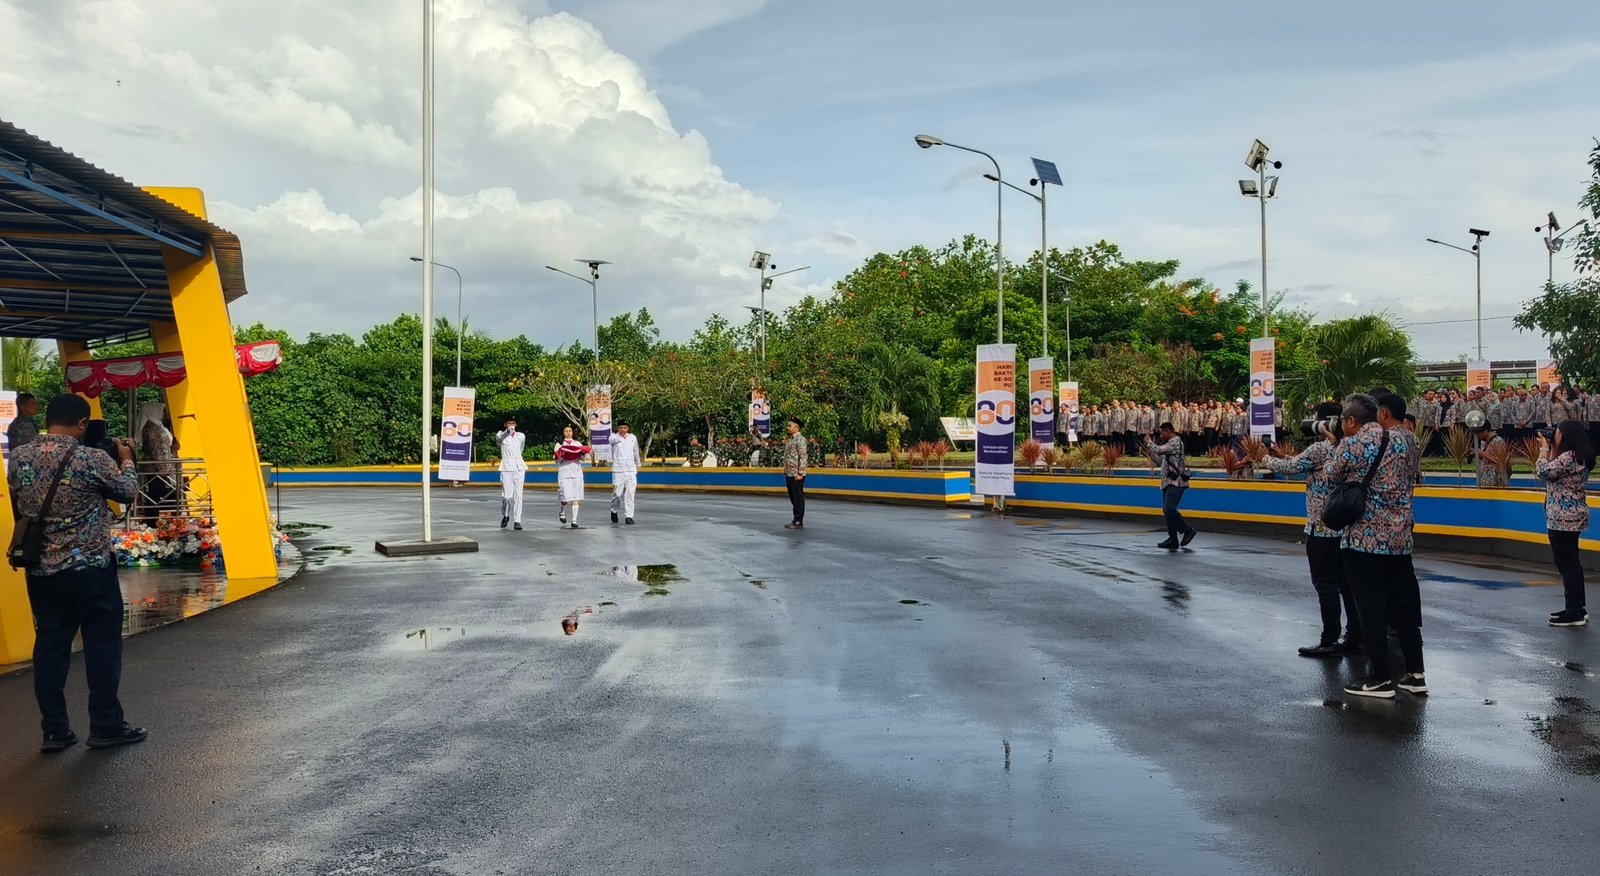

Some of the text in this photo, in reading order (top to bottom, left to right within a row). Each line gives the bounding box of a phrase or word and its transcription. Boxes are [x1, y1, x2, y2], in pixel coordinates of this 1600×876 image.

[1251, 379, 1274, 398] 80
[753, 402, 770, 416] 80
[977, 400, 1014, 425] 80
[1031, 397, 1053, 416] 80
[590, 413, 610, 425] 80
[443, 421, 472, 438] 80
